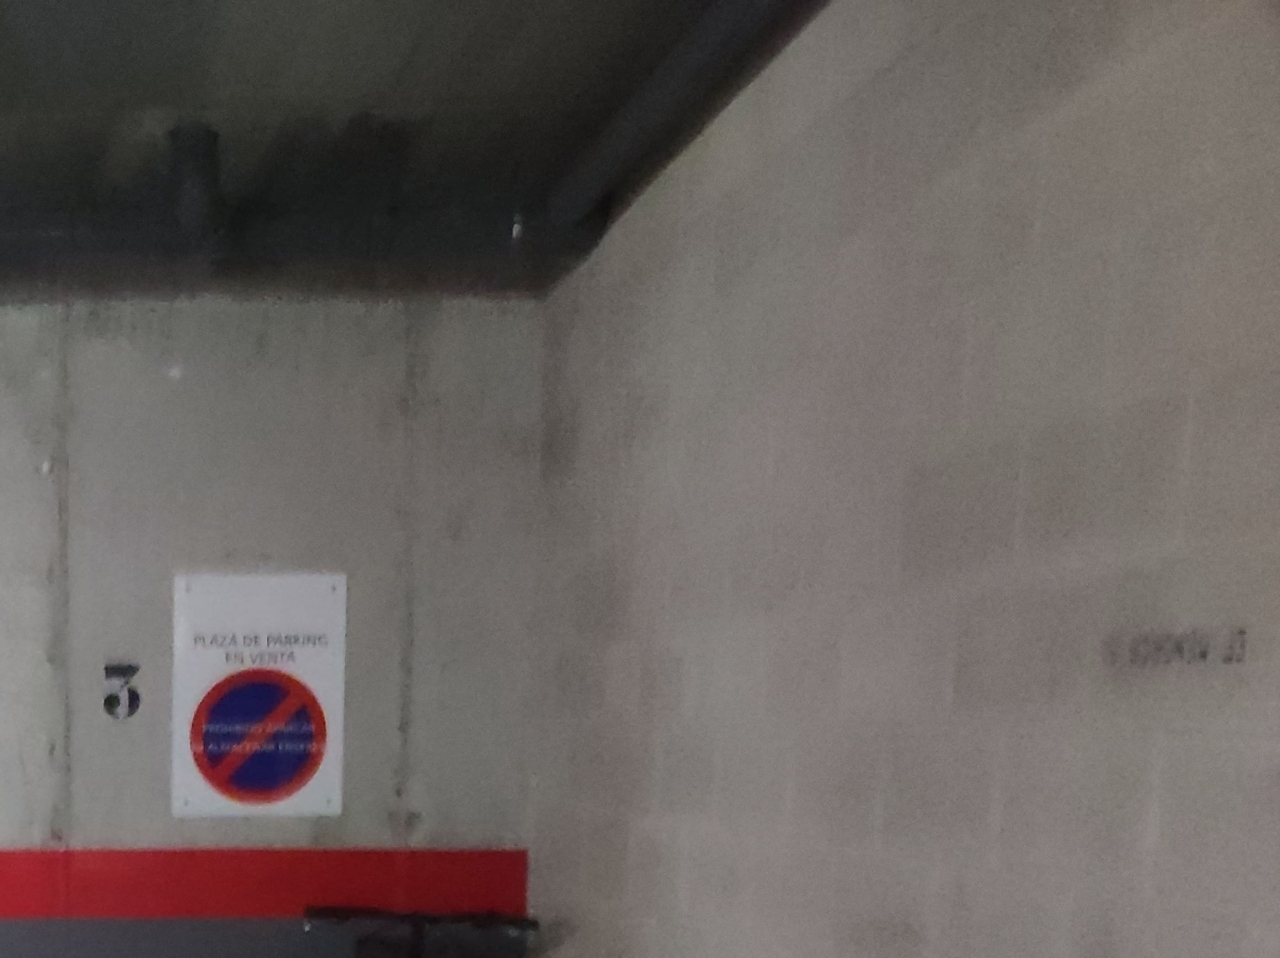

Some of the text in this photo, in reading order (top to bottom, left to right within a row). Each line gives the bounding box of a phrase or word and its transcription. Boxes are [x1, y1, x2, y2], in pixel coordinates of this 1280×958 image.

[194, 634, 329, 648] PLAZA DE PARKING
[225, 651, 296, 665] EN VENTA
[104, 664, 140, 719] 3
